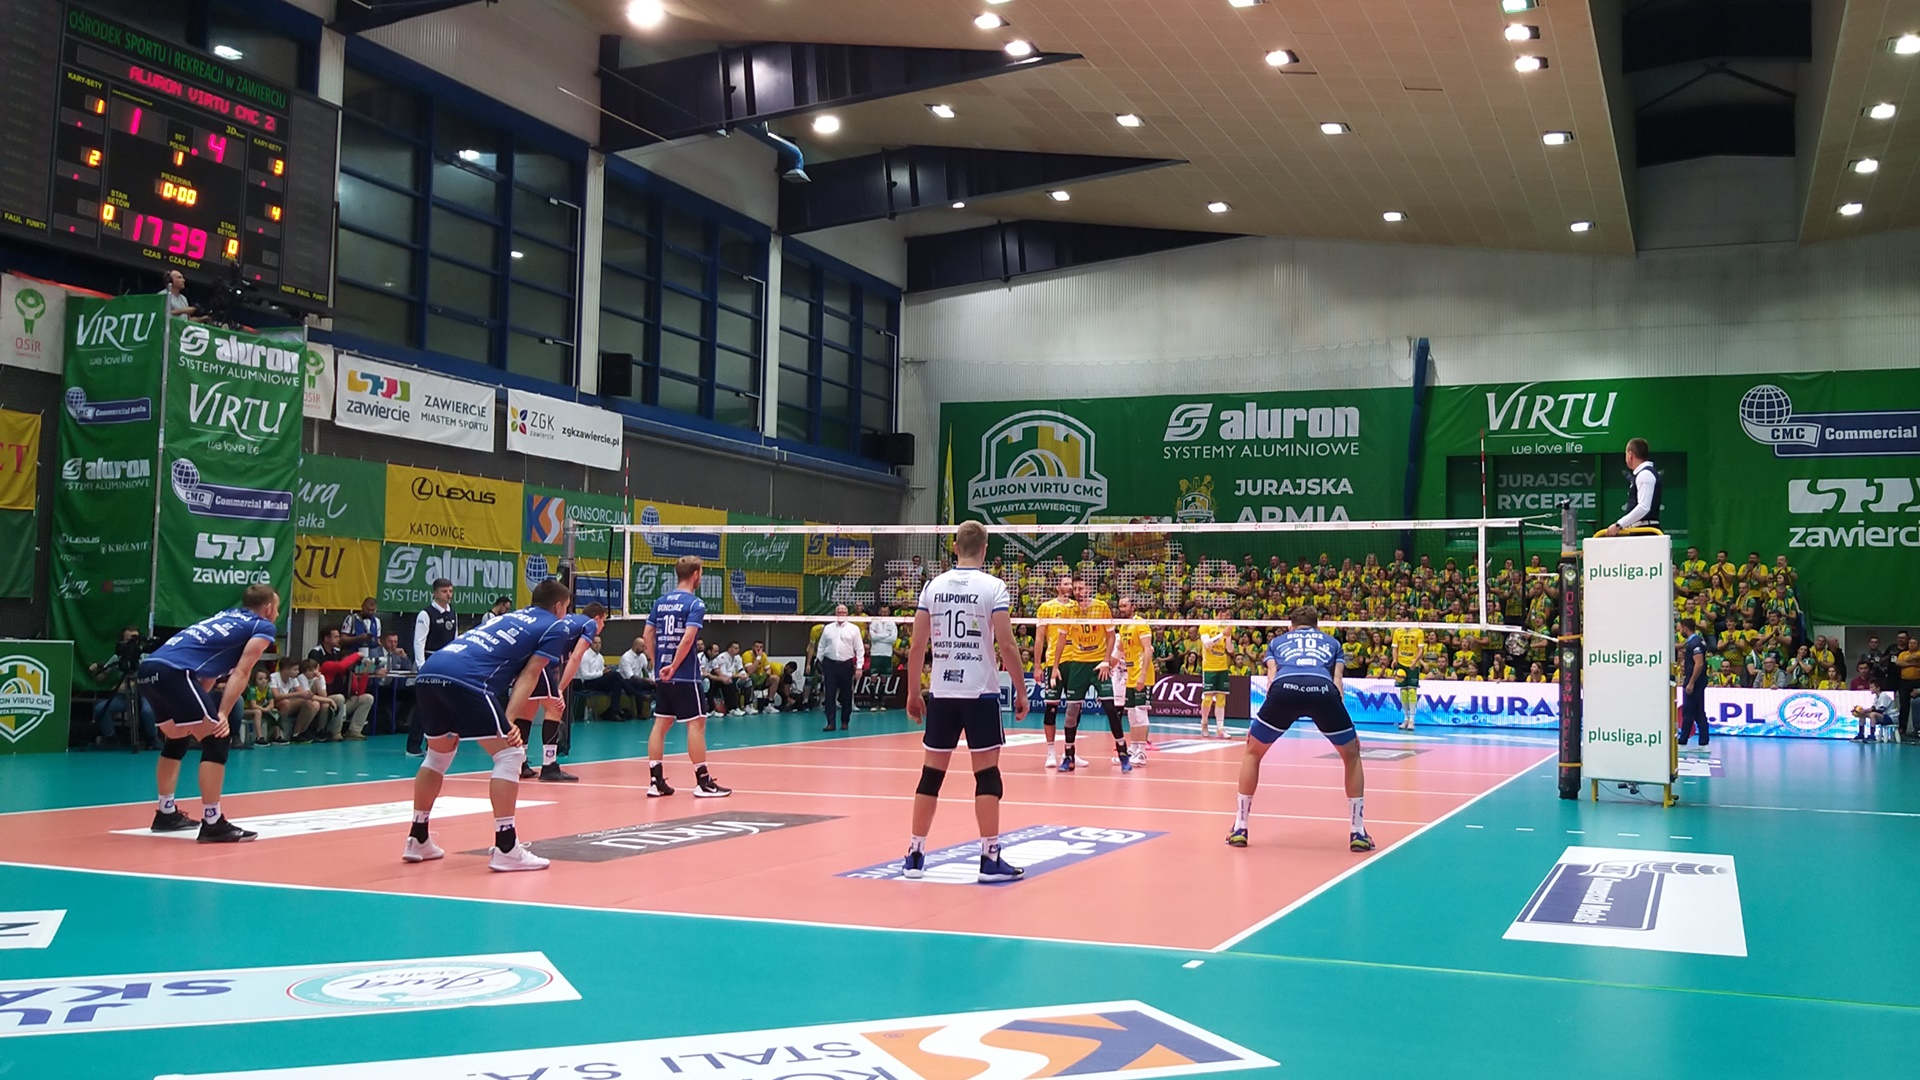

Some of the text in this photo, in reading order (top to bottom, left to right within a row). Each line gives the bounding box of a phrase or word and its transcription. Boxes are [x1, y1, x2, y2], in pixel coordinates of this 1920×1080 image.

[69, 10, 122, 46] OŚRODEK
[124, 31, 167, 63] SPORTU
[174, 51, 225, 85] REKREACJI
[236, 76, 287, 109] ZAWIERCIU
[67, 72, 104, 91] KARY-SETY
[129, 65, 184, 97] ALURON
[187, 86, 231, 115] VIRTU
[234, 104, 260, 125] CMC
[130, 106, 143, 136] 1
[88, 148, 102, 167] 2
[207, 132, 228, 164] 4
[273, 159, 285, 176] 3
[110, 189, 129, 201] STAN
[162, 180, 199, 206] 0:00
[4, 212, 47, 231] FAUL PUNKTY
[102, 203, 116, 221] 0
[271, 206, 283, 221] 4
[226, 238, 240, 257] 0
[142, 248, 201, 270] CZAS CZAS GRY
[76, 304, 157, 351] VIRTU
[15, 337, 41, 353] OSiR
[178, 355, 226, 374] SYSTEMY
[214, 335, 300, 375] aluron
[189, 381, 288, 442] VIRTU
[346, 400, 410, 423] zawiercie
[424, 394, 487, 418] ZAWIERCIE
[1485, 381, 1618, 439] VIRTU
[421, 412, 489, 432] MIASTEM SPORTU
[530, 411, 555, 431] ZGK
[1219, 402, 1360, 441] aluron
[562, 426, 620, 447] zgkzawiercie.pl
[1771, 426, 1918, 440] CMC Commercial
[1163, 442, 1360, 460] SYSTEMY ALUMINIOWE
[1511, 441, 1583, 455] we love life
[85, 457, 151, 480] aluron
[1234, 478, 1354, 497] JURAJSKA
[1498, 472, 1595, 488] JURAJSCY
[436, 484, 496, 505] LEXUS
[972, 482, 1103, 500] ALURON VIRTU CMC
[215, 495, 262, 510] Commercial
[991, 502, 1081, 515] WARTA ZAWIERCIE
[298, 513, 326, 529] ałka
[565, 504, 632, 525] KONSORCJUM
[409, 522, 465, 541] KATOWICE
[192, 565, 271, 584] zawiercie
[425, 550, 514, 589] aluron
[1589, 562, 1663, 581] plusliga.pl
[933, 593, 979, 605] FILIPOWICZ
[663, 614, 675, 635] 18
[945, 609, 966, 639] 16
[933, 641, 980, 650] MIASTO SUWAŁKI
[1294, 638, 1317, 649] 10
[1588, 649, 1663, 667] plusliga.pl
[1282, 681, 1331, 695] reso.com.pl
[13, 697, 35, 705] VIRTU
[1588, 727, 1662, 746] plusliga.pl
[589, 819, 786, 850] VIRTU
[659, 1041, 861, 1066] STALI
